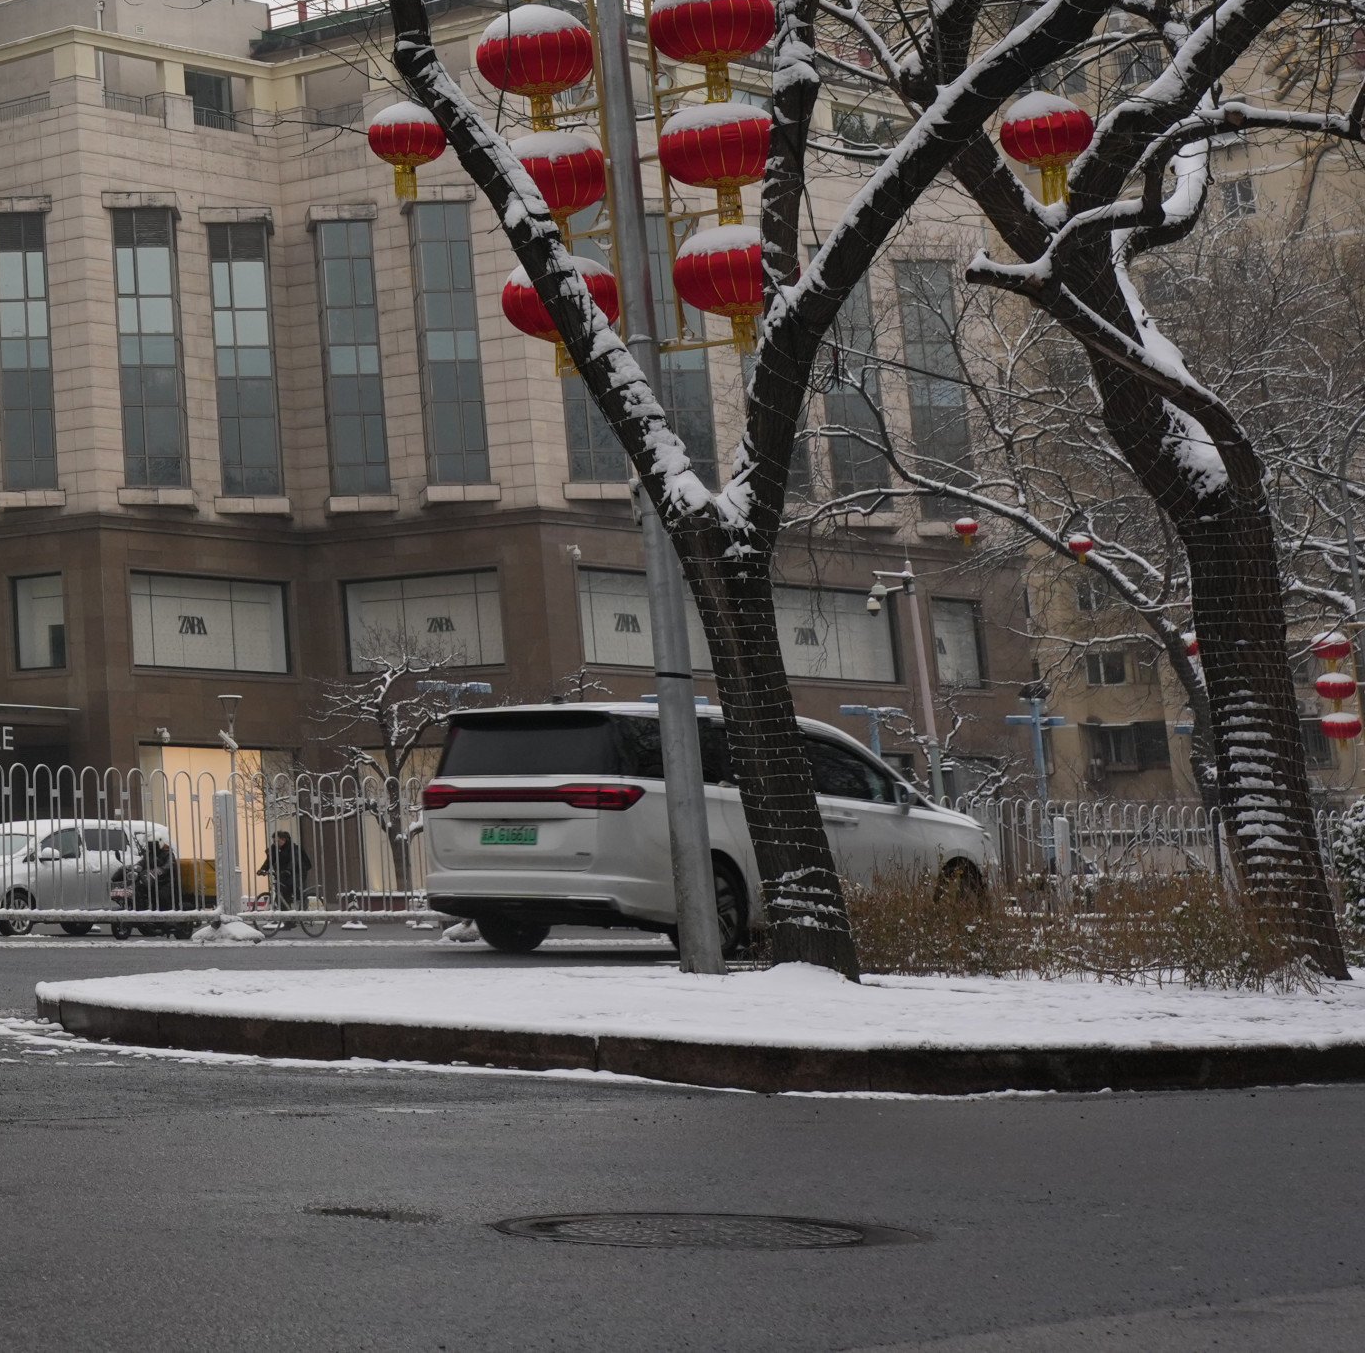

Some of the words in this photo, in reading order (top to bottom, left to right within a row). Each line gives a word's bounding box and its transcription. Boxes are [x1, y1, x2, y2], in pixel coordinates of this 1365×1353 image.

[178, 615, 208, 636] ZARA
[426, 616, 456, 633] ZARA
[613, 612, 641, 633] ZARA
[794, 627, 820, 647] ZARA
